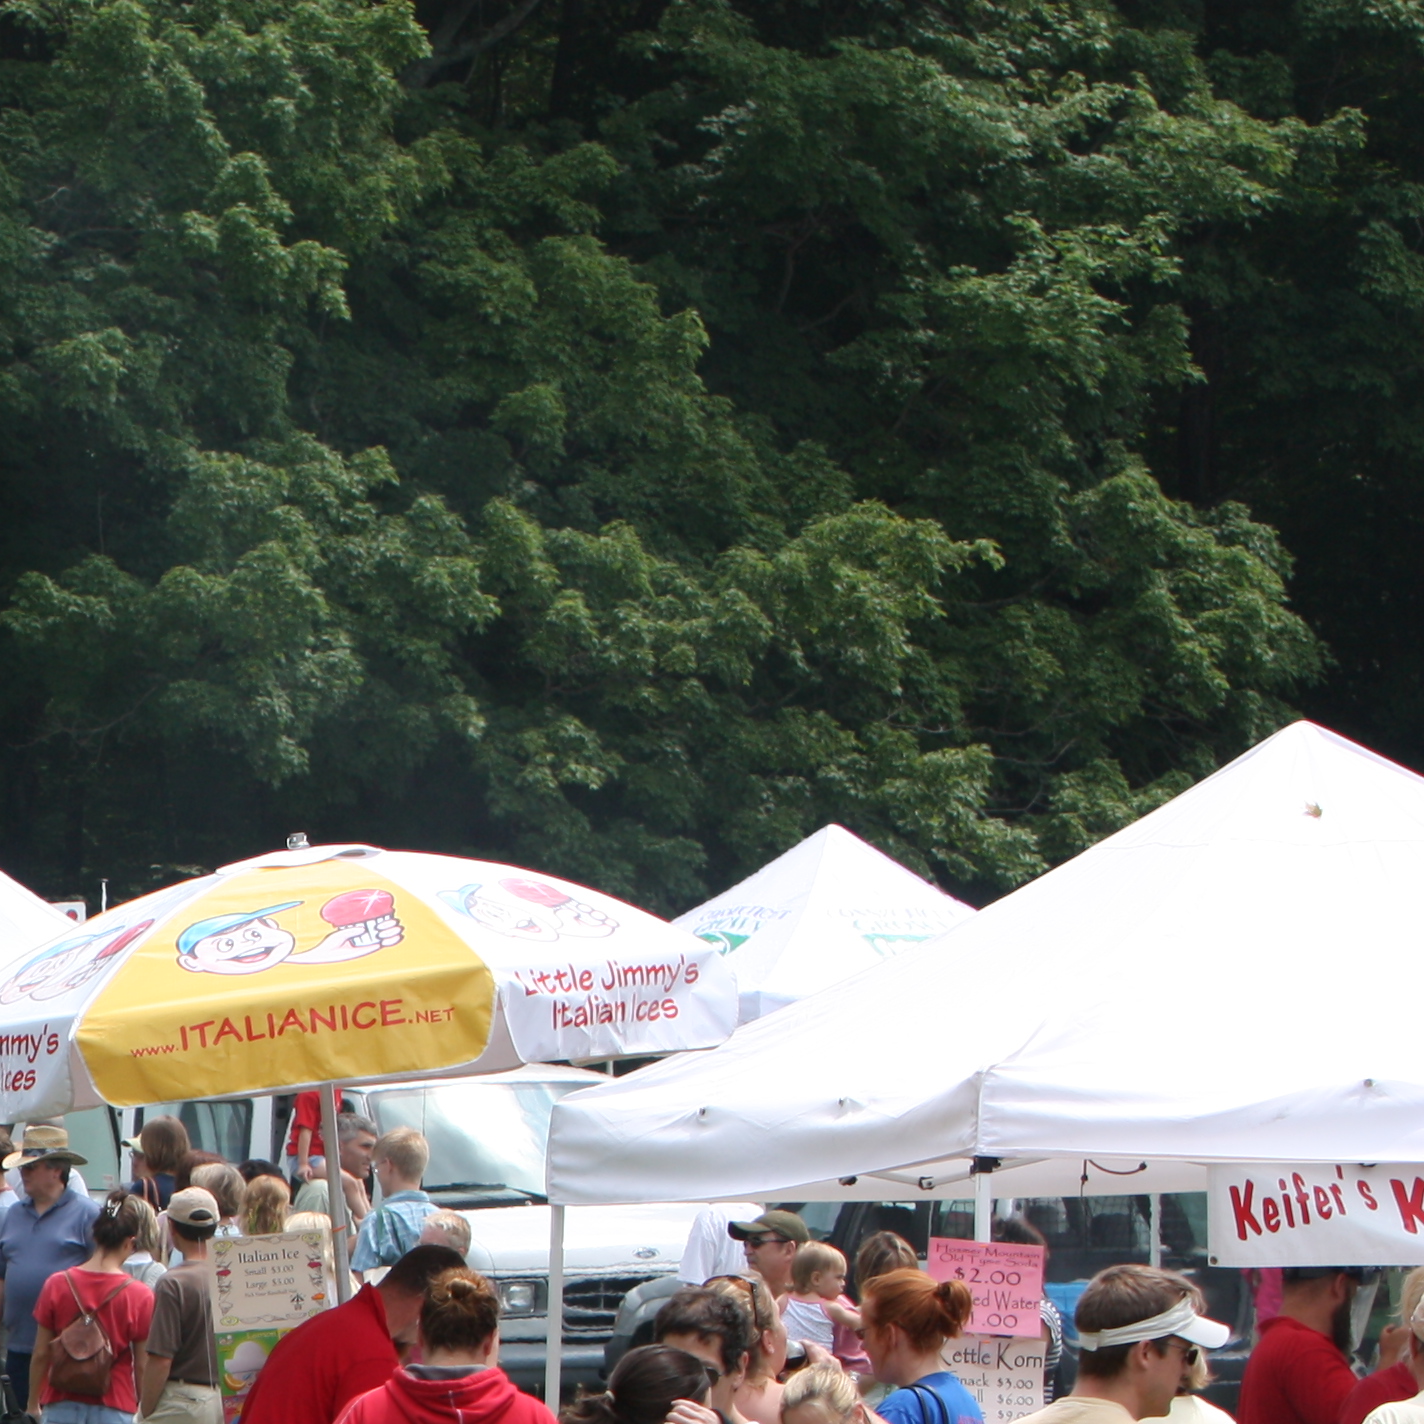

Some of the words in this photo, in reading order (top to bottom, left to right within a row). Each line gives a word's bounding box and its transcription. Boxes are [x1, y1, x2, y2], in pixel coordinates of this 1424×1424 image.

[514, 963, 594, 996] Little
[601, 953, 700, 993] Jimmy's
[552, 995, 626, 1031] Italian
[631, 992, 679, 1023] Ices
[130, 998, 456, 1058] www.ITALIANICE.NET
[0, 1062, 37, 1092] Ices
[1228, 1164, 1379, 1241] Keifer's
[238, 1250, 278, 1264] Italian
[282, 1248, 300, 1260] Ice
[939, 1252, 964, 1263] Old
[1004, 1259, 1039, 1268] Soda
[985, 1247, 1040, 1259] Mountain
[244, 1267, 267, 1277] Small
[953, 1266, 1021, 1285] $2.00
[246, 1281, 267, 1290] Large
[994, 1290, 1039, 1311] Water
[997, 1342, 1043, 1371] Korn
[997, 1377, 1034, 1390] $3.00
[997, 1393, 1034, 1406] $6.00
